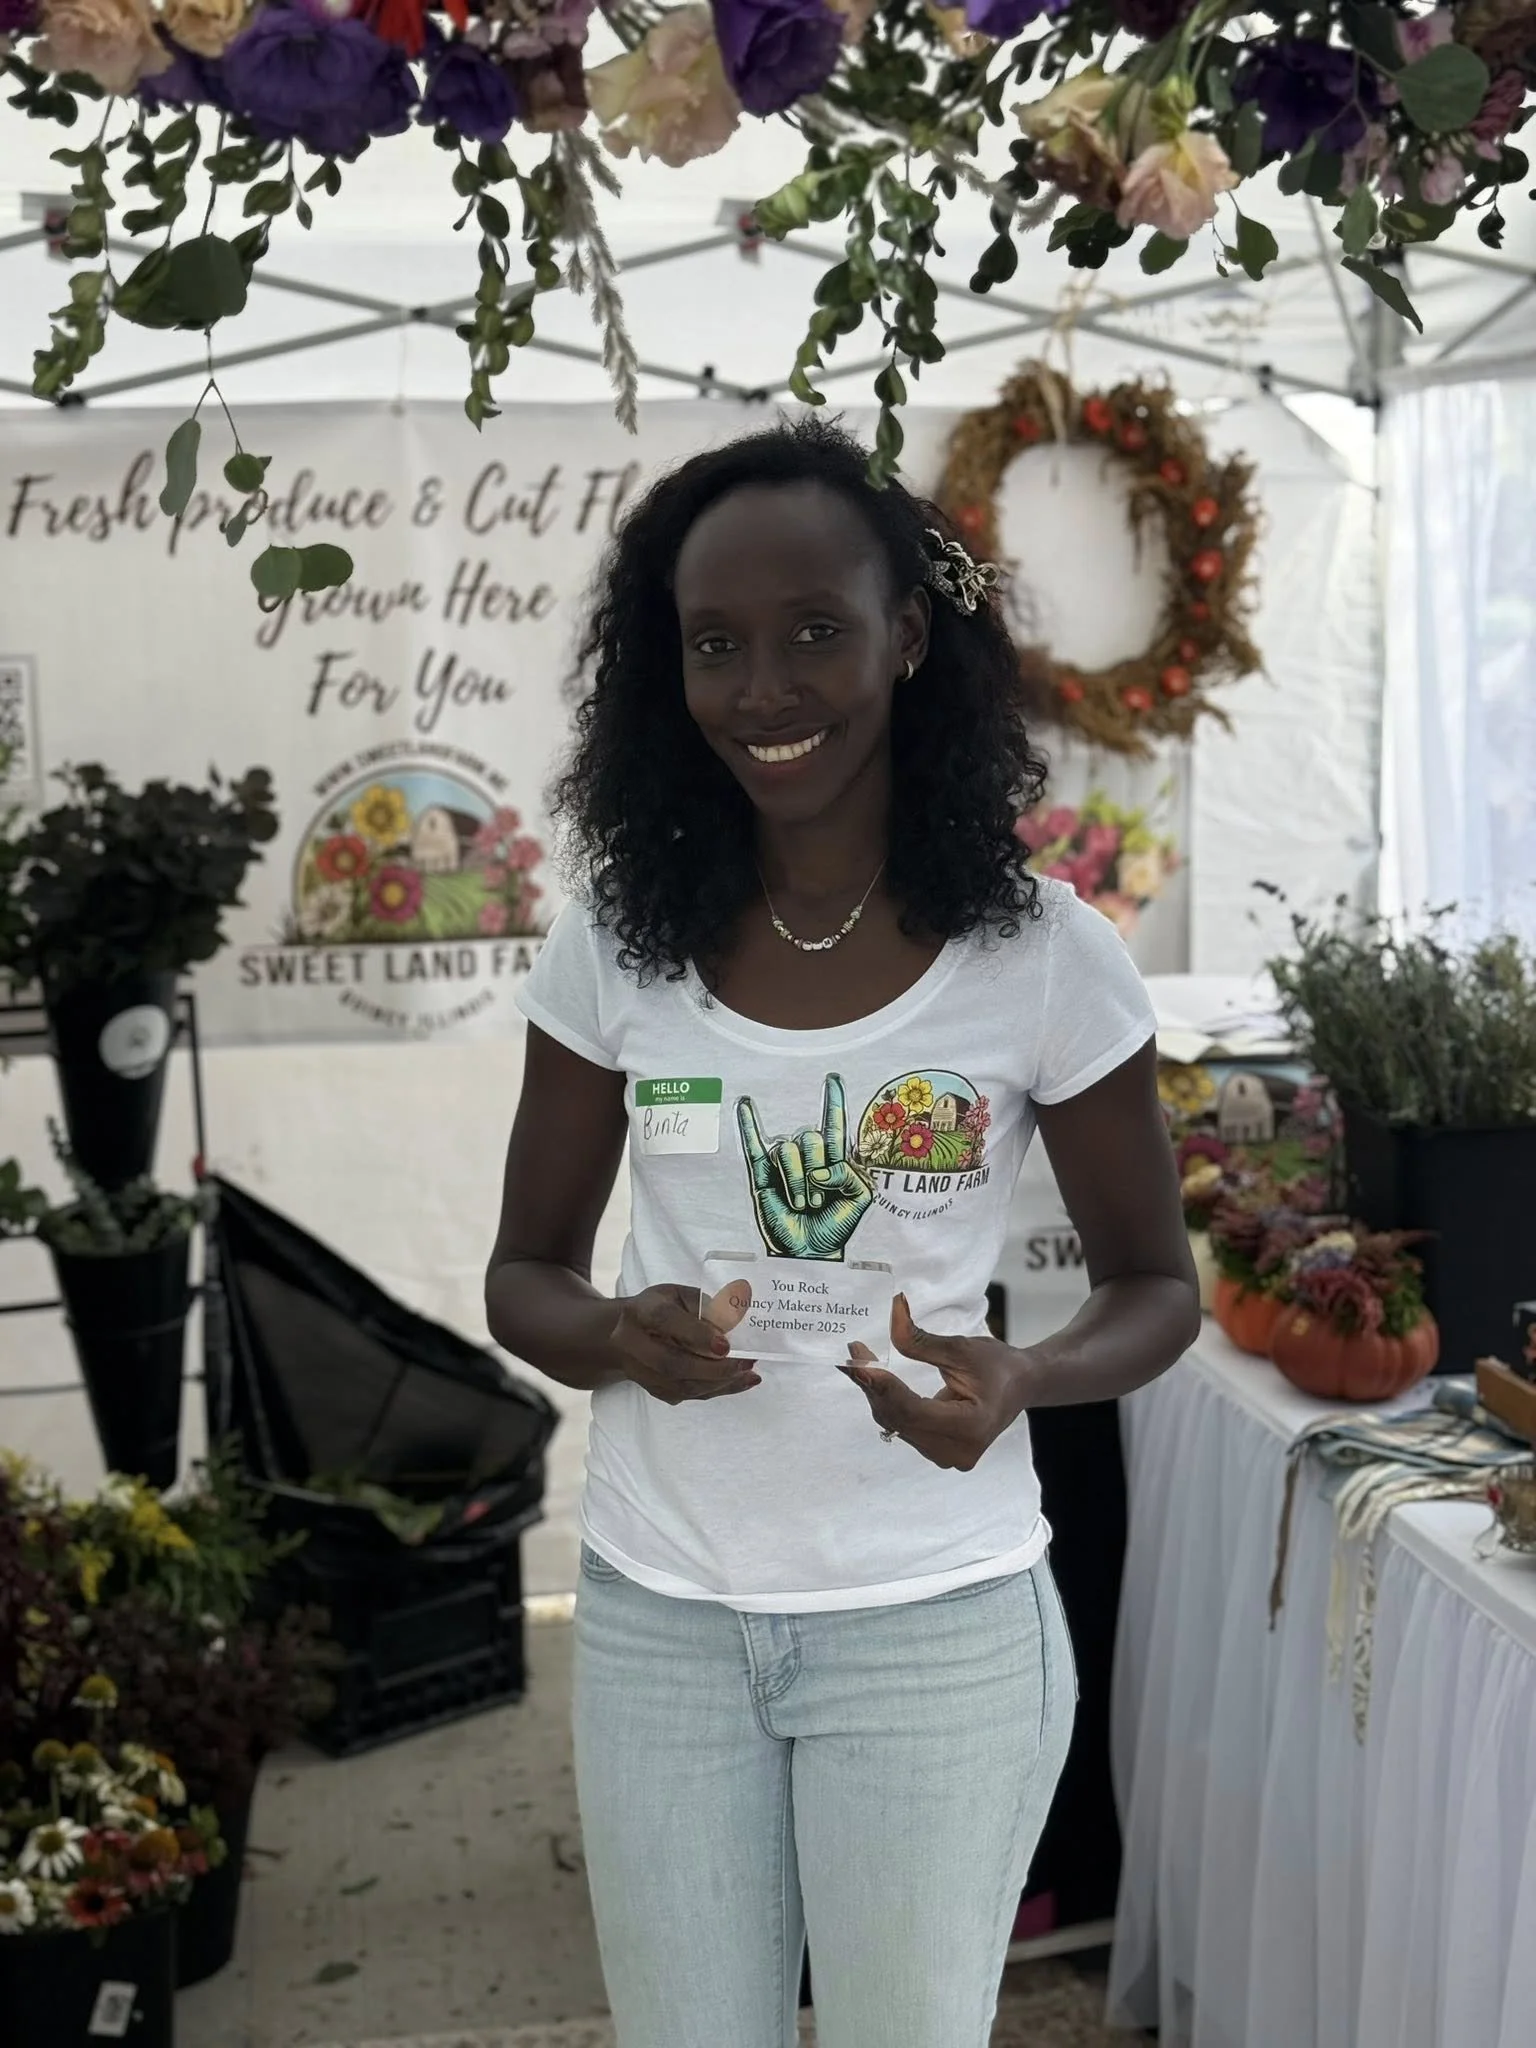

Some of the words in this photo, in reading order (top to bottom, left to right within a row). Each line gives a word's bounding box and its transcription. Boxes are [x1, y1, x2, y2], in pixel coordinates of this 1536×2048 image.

[6, 448, 158, 542] Fresh
[167, 467, 392, 558] produce
[412, 475, 443, 528] &
[463, 458, 563, 537] Cut
[443, 556, 558, 627] Here
[306, 648, 400, 717] For
[412, 647, 515, 734] You
[237, 950, 368, 986] SWEET
[384, 947, 478, 983] LAND
[652, 1082, 690, 1095] HELLO
[643, 1108, 689, 1140] Binta
[903, 1174, 950, 1194] LAND
[956, 1167, 990, 1192] FARM
[912, 1198, 953, 1220] ILLINOIS
[771, 1280, 794, 1292] You
[799, 1282, 829, 1295] Rock
[729, 1295, 774, 1313] Quincy
[777, 1299, 822, 1313] Makers
[826, 1303, 869, 1317] Market
[749, 1316, 814, 1331] September
[817, 1321, 846, 1333] 2025
